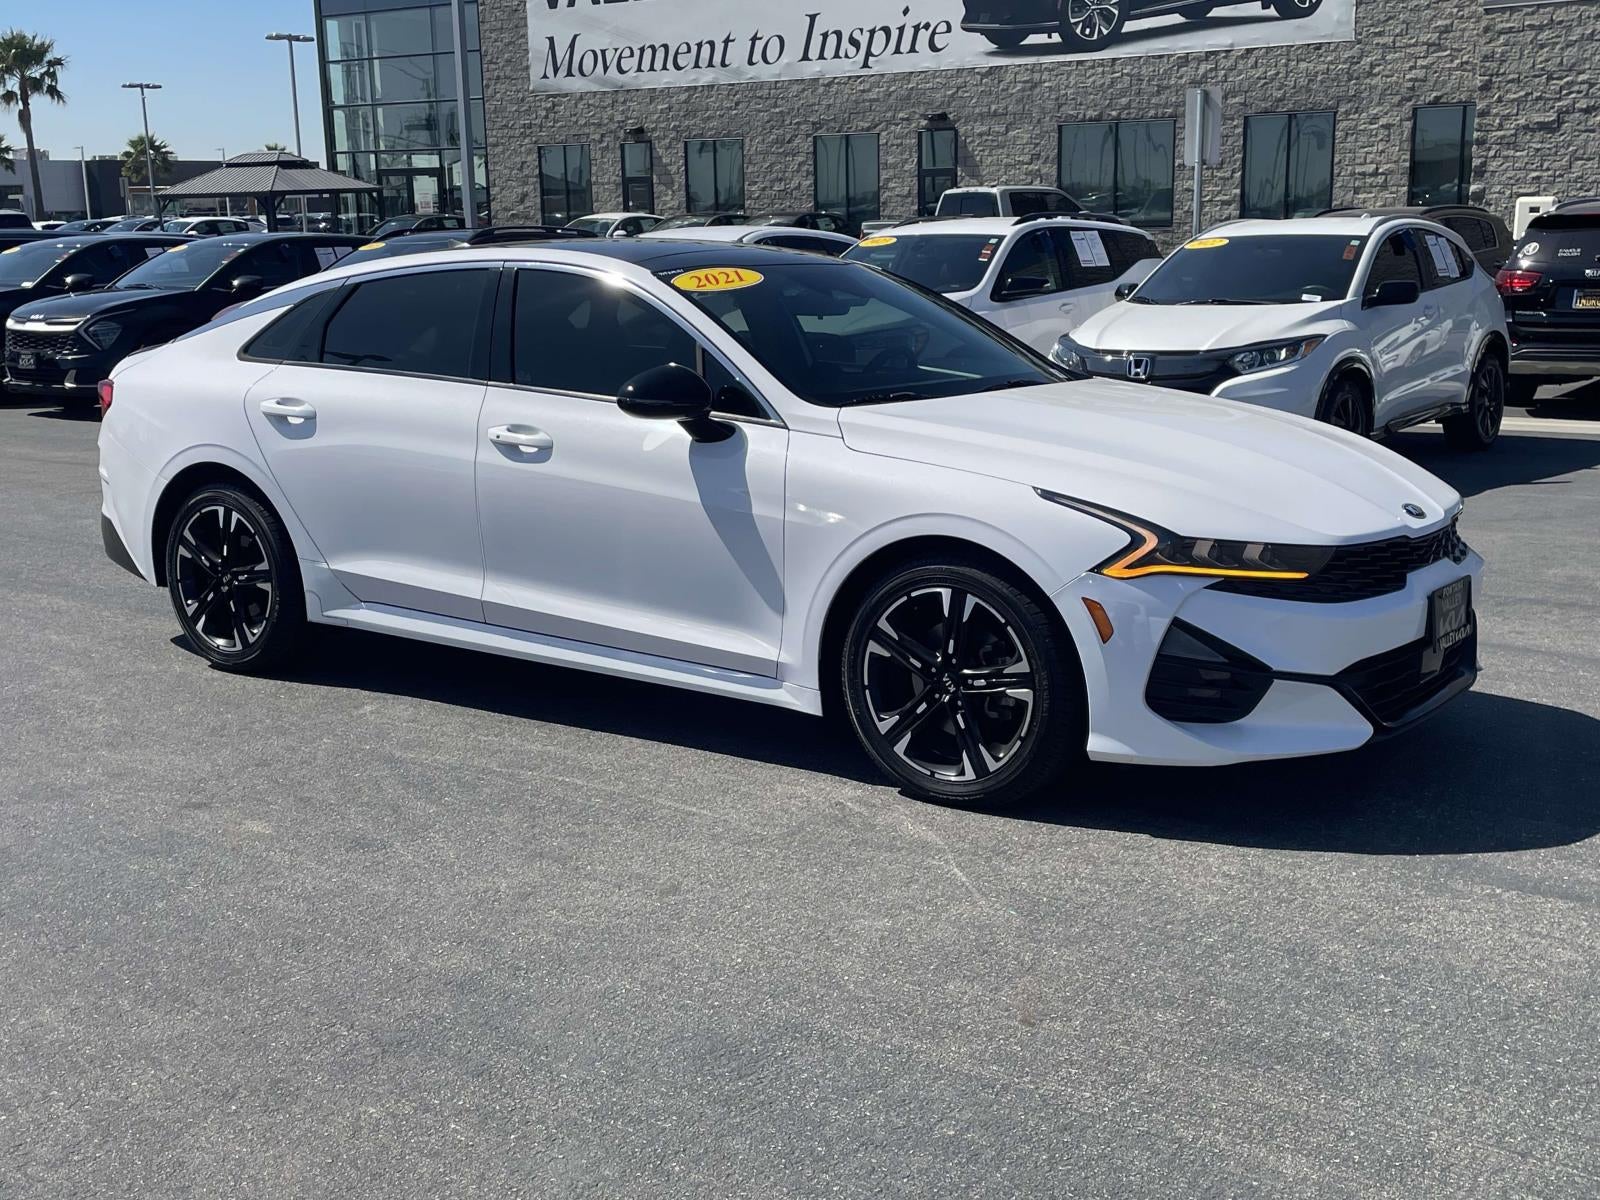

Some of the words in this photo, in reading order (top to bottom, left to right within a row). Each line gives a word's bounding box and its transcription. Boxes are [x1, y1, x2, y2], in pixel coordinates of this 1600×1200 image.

[540, 31, 736, 80] Movement
[746, 29, 785, 67] to
[797, 5, 952, 69] Inspire
[690, 270, 746, 288] 2021
